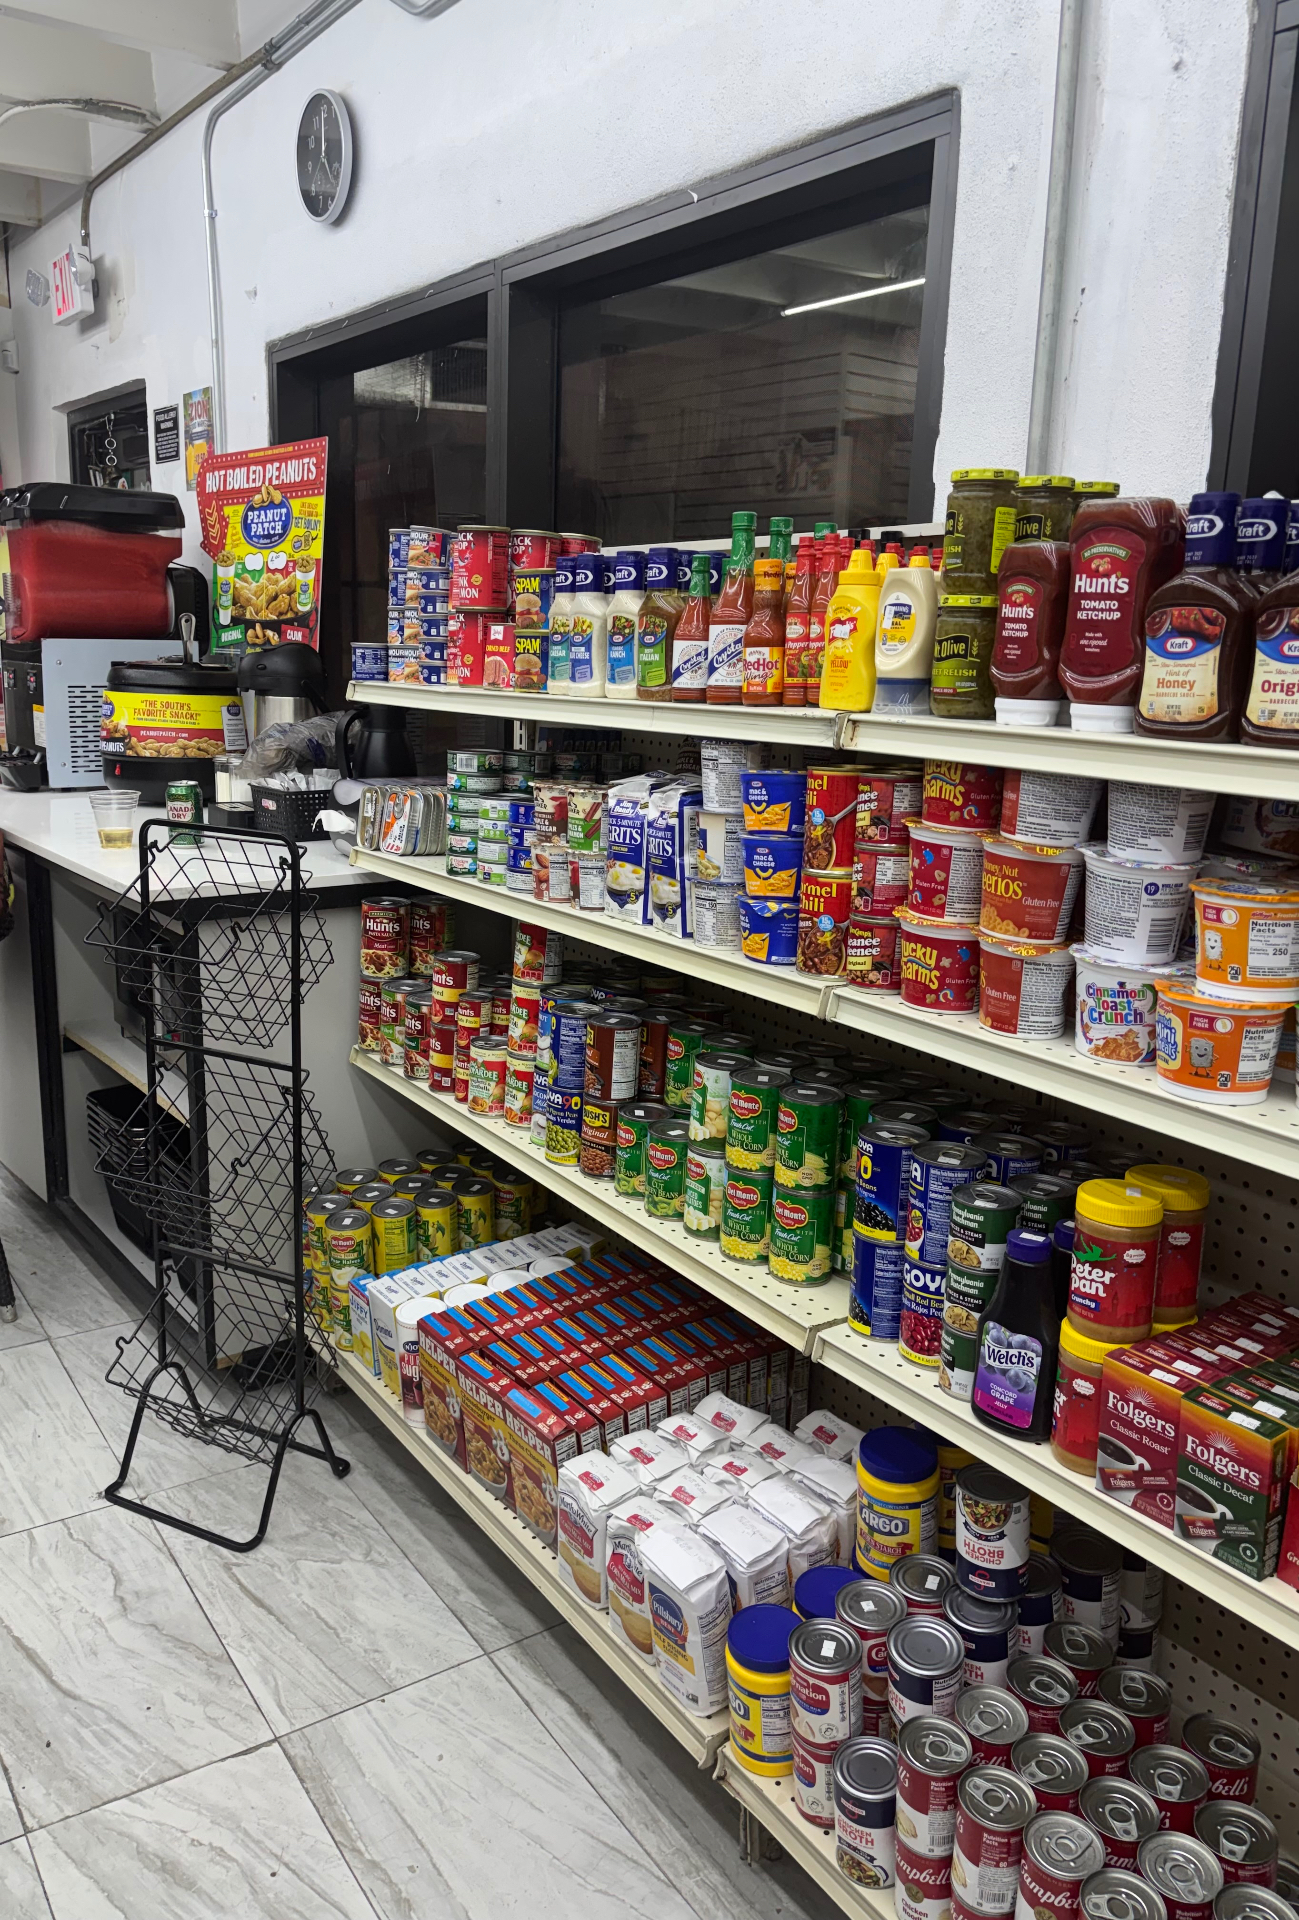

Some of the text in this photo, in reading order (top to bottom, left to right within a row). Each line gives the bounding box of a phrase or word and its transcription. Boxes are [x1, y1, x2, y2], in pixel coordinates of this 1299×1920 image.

[308, 135, 315, 150] 10
[307, 161, 312, 174] 9
[53, 252, 75, 317] EXIT
[189, 399, 208, 421] ZION
[206, 457, 317, 493] HOT BOILED PEANUTS
[247, 508, 287, 524] PEANUT
[250, 521, 283, 536] PATCH
[1186, 520, 1210, 534] Kraft
[1237, 524, 1264, 537] Kraft
[1091, 546, 1127, 557] PRESERVATIVES
[516, 577, 540, 594] SPAM
[1074, 573, 1129, 594] Hunt's
[1001, 603, 1034, 619] Hunt's
[1080, 600, 1119, 610] TOMATO
[1077, 610, 1121, 621] KETCHUP
[1002, 629, 1029, 638] KETCHUP
[1004, 622, 1028, 631] TOMATO
[221, 629, 242, 642] ORIGINAL
[287, 629, 303, 642] CAJUN
[516, 638, 540, 654] SPAM
[942, 640, 966, 656] Olive
[1169, 640, 1189, 650] Kraft
[640, 652, 660, 661] ITALIAN
[681, 651, 707, 673] Crystal
[743, 658, 778, 672] RedHot
[744, 671, 774, 684] Wings
[944, 668, 977, 677] RELISH
[1165, 669, 1191, 678] Hint of
[1157, 677, 1197, 692] Honey
[160, 701, 192, 711] SOUTH'S
[133, 708, 168, 719] FAVORITE
[101, 741, 124, 753] PEANUTS
[171, 812, 187, 820] DRY
[608, 825, 641, 845] GRITS
[1002, 865, 1019, 877] Nut
[1022, 896, 1060, 908] Gluten Free
[366, 917, 400, 932] Hunt's
[1251, 920, 1292, 929] Nutrition
[901, 938, 938, 964] Lucky
[1273, 948, 1289, 956] 250
[1228, 966, 1241, 976] 250
[985, 986, 1017, 1002] Gluten Free
[1086, 983, 1147, 1000] Cinnamon
[1096, 999, 1134, 1012] Toast
[1089, 1007, 1145, 1026] Crunch
[1244, 1028, 1275, 1036] Nutrition
[1259, 1053, 1270, 1061] 250
[1218, 1073, 1231, 1083] 250
[741, 1100, 760, 1112] Monte
[557, 1115, 576, 1125] Verdes
[584, 1107, 608, 1124] BUSH'S
[582, 1125, 609, 1139] Original
[731, 1130, 753, 1143] WHOLE
[743, 1140, 764, 1152] CORN
[657, 1150, 675, 1162] Monte
[652, 1181, 664, 1190] CUT
[860, 1182, 877, 1192] Beans
[657, 1188, 679, 1199] BEANS
[727, 1187, 758, 1202] Del Monte
[775, 1205, 806, 1221] Del Monte
[727, 1220, 750, 1234] WHOLE
[741, 1230, 761, 1241] CORN
[966, 1230, 982, 1239] STEMS
[775, 1240, 798, 1254] WHOLE
[789, 1250, 810, 1262] CORN
[1071, 1254, 1115, 1284] Peter
[915, 1295, 929, 1306] Red
[966, 1295, 982, 1304] STEMS
[1071, 1294, 1096, 1309] Crunchy
[913, 1302, 932, 1314] Rojos
[419, 1331, 457, 1378] HELPER
[986, 1344, 1035, 1369] Welch's
[1121, 1354, 1146, 1369] Folgers
[420, 1354, 451, 1385] Three Cheese
[458, 1370, 504, 1418] HELPER
[990, 1382, 1018, 1399] CONCORD
[990, 1389, 1015, 1406] GRAPE
[1226, 1385, 1251, 1400] Folgers
[460, 1390, 496, 1423] Cheeseburger
[994, 1399, 1008, 1410] JELLY
[1197, 1394, 1225, 1412] Folgers
[1107, 1389, 1175, 1438] Folgers
[505, 1408, 553, 1463] HELPER
[1110, 1419, 1169, 1455] Classic Roast
[508, 1432, 547, 1470] Three Cheese
[1185, 1433, 1261, 1486] Folgers
[1110, 1477, 1136, 1488] Folgers
[1188, 1465, 1254, 1505] Classic Decaf
[575, 1511, 593, 1535] White
[862, 1507, 903, 1535] ARGO
[1188, 1525, 1217, 1537] Folgers
[876, 1540, 902, 1554] STARCH
[963, 1538, 1004, 1559] BROTH
[964, 1551, 1002, 1565] CHICKEN
[653, 1599, 683, 1630] Pillsbury
[660, 1618, 675, 1634] BEST
[653, 1629, 689, 1662] SELF RISING
[838, 1817, 872, 1837] CHICKEN
[839, 1823, 875, 1847] BROTH
[983, 1832, 1008, 1843] Nutrition
[983, 1837, 999, 1847] Facts
[901, 1898, 929, 1918] Chicken
